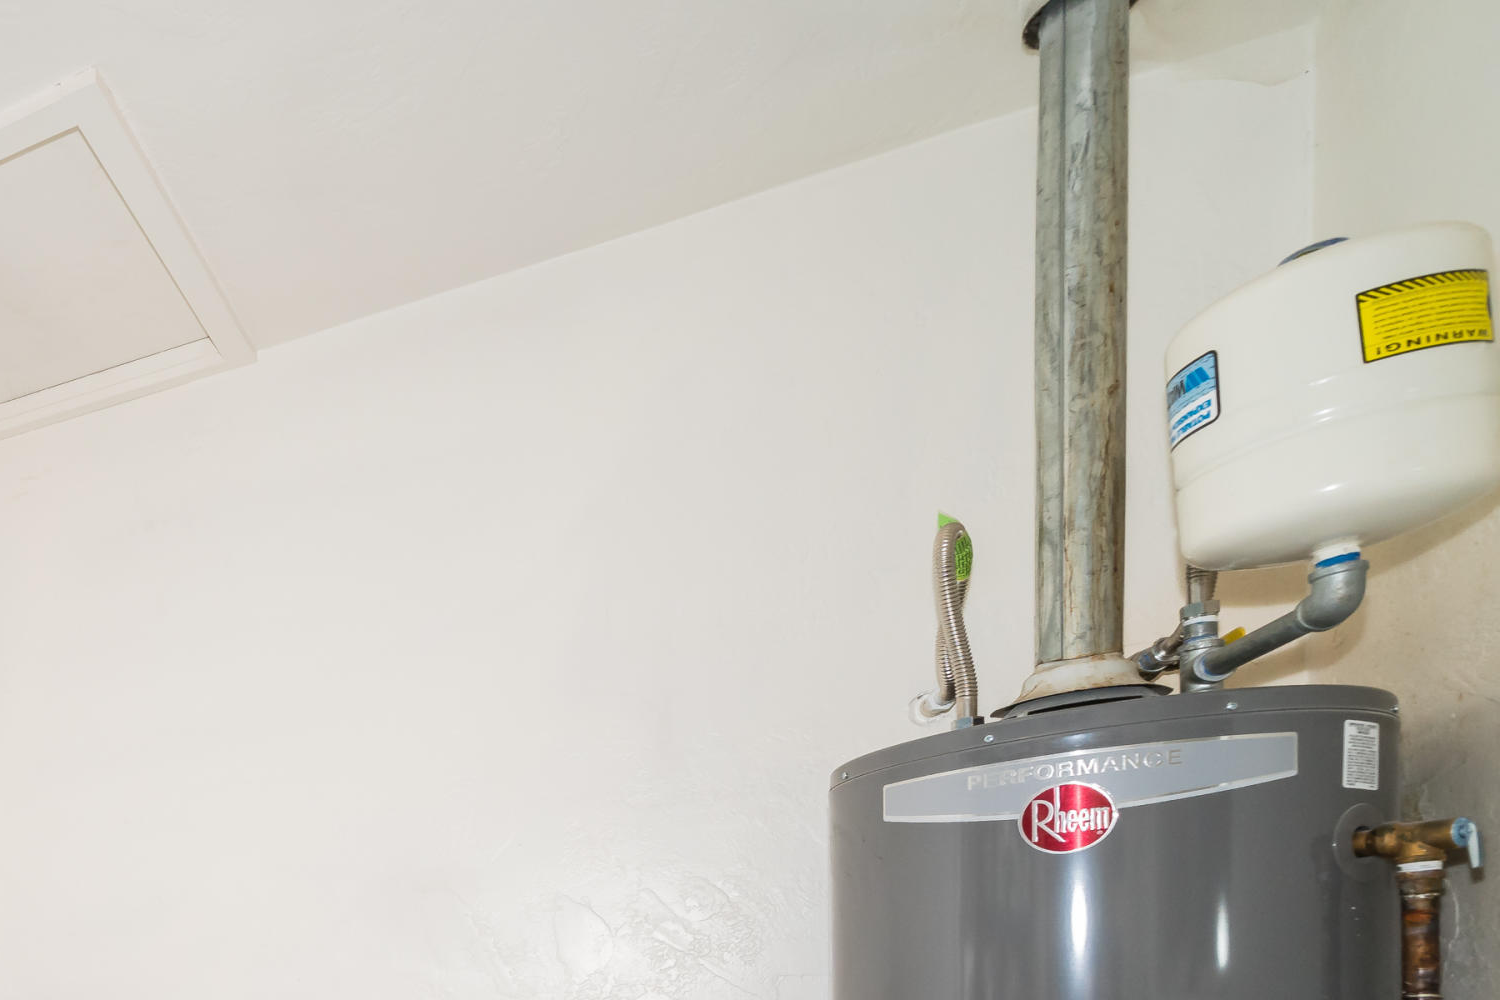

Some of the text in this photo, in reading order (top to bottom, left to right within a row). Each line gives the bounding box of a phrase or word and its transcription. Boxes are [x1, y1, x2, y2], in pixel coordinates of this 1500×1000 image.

[1376, 329, 1488, 356] WARNING!
[967, 749, 1183, 791] PERFORMANCE
[1031, 786, 1110, 843] Rheem
